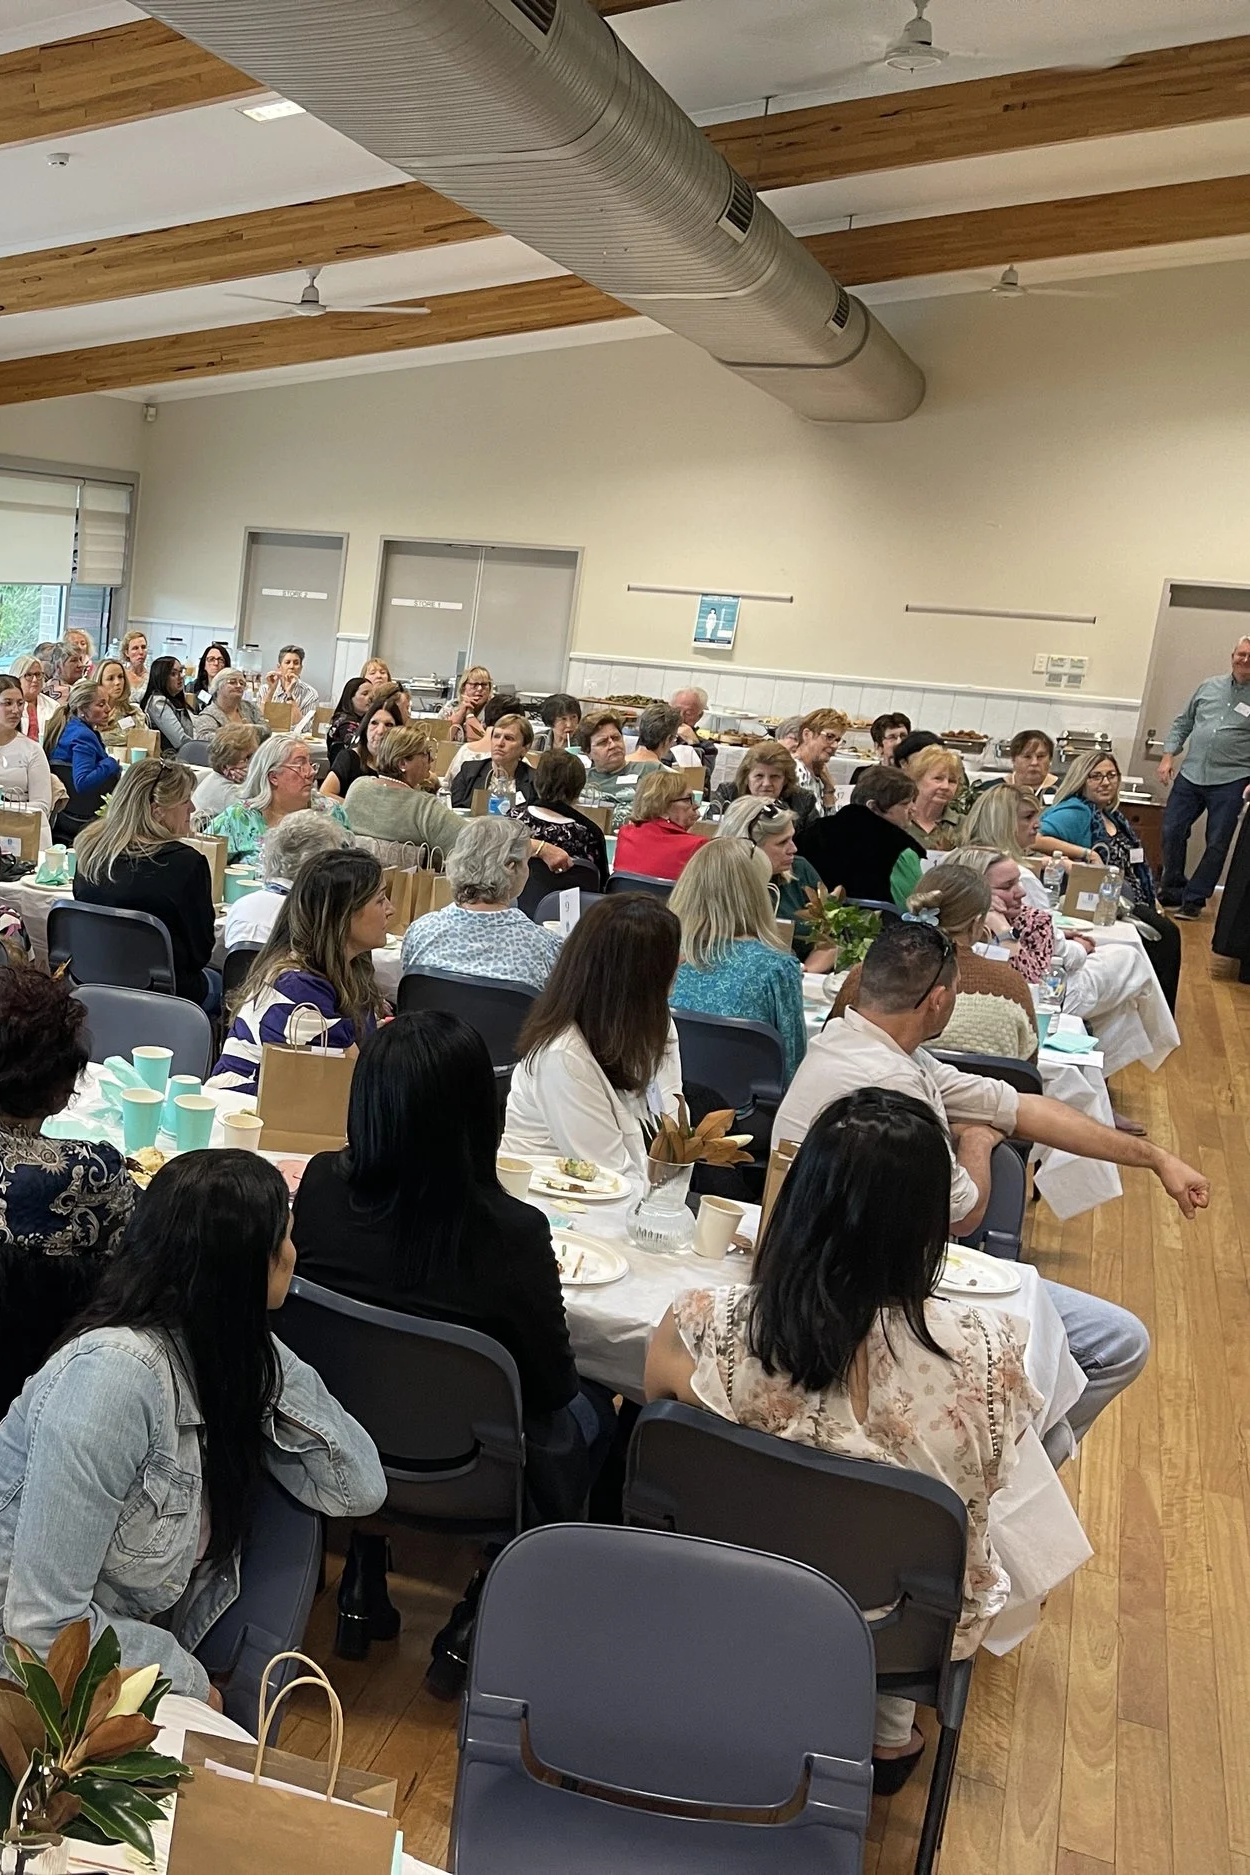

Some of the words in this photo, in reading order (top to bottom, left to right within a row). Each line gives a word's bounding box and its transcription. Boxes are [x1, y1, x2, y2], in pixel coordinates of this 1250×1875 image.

[282, 590, 302, 599] STORE
[413, 600, 435, 608] STORE
[565, 901, 570, 912] 9
